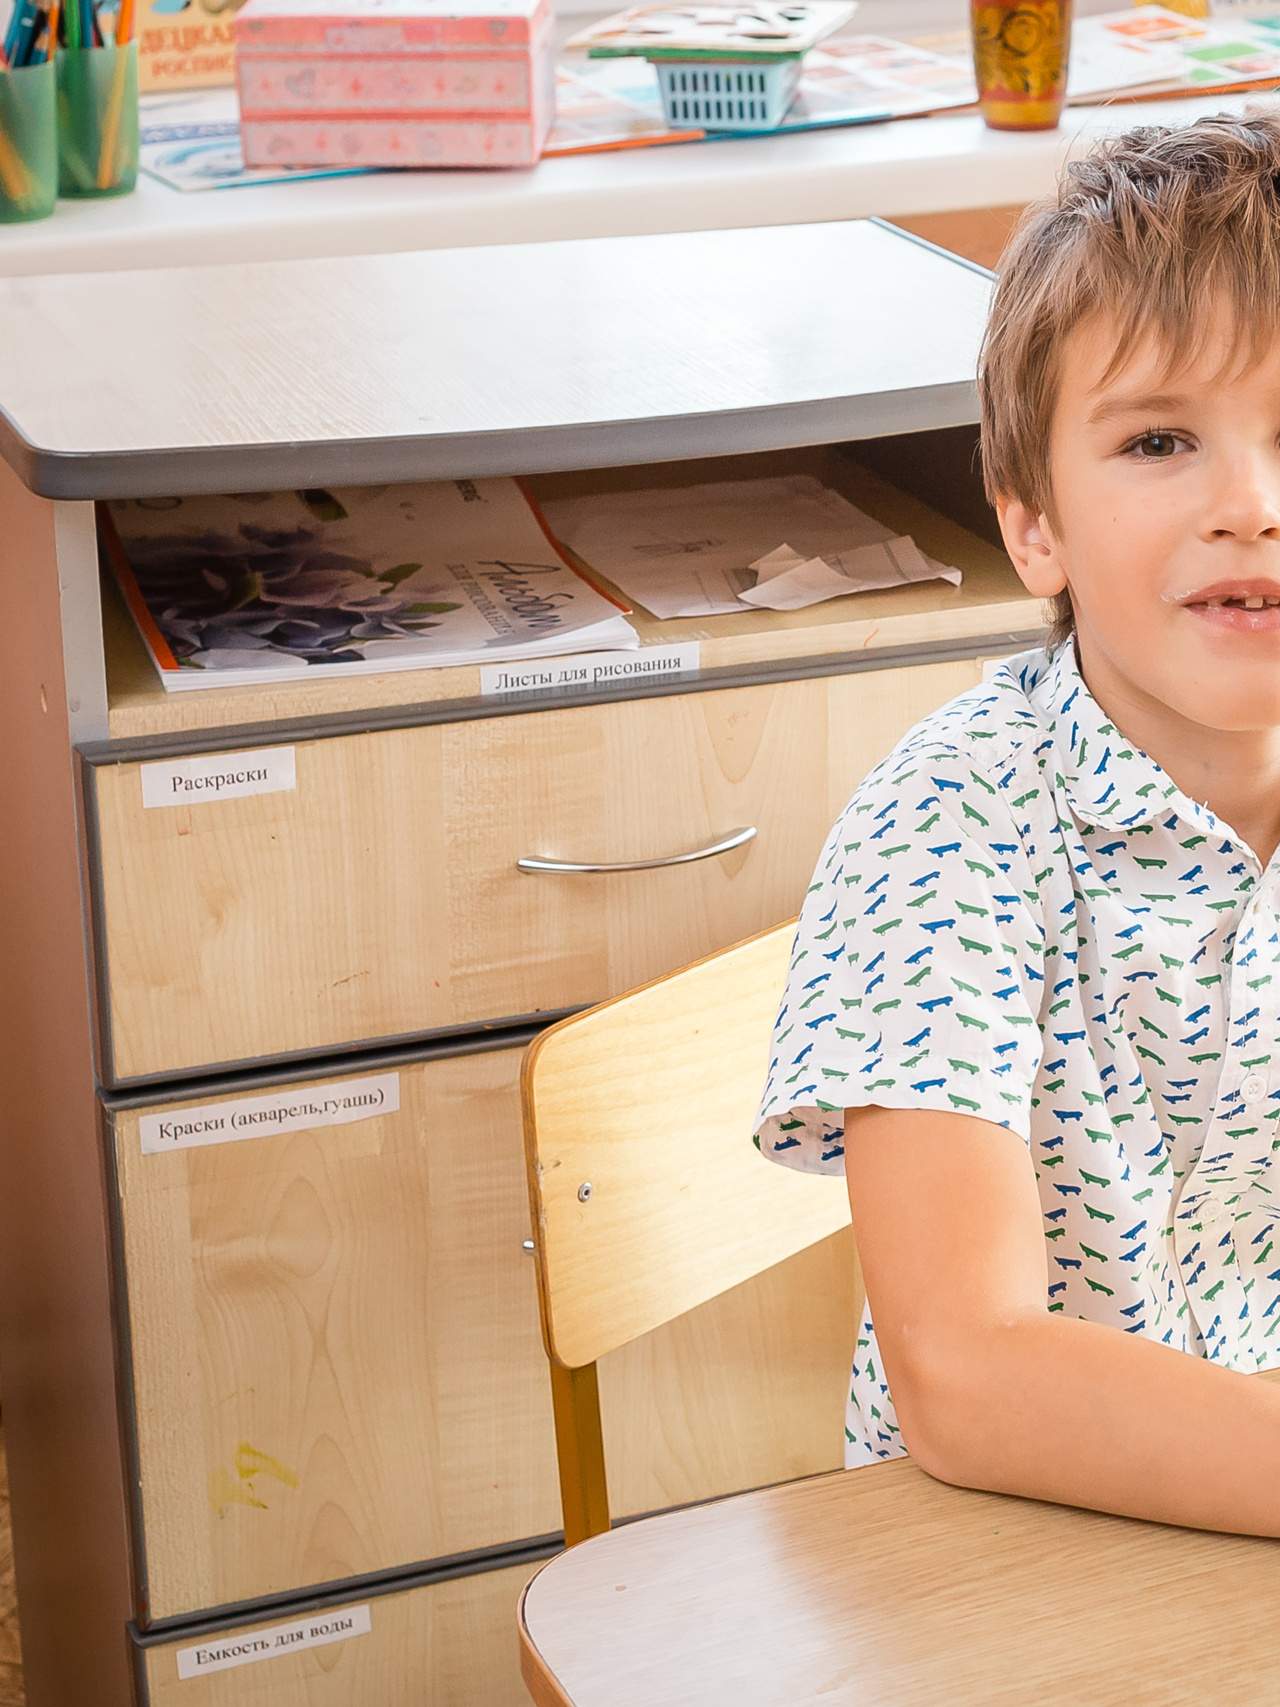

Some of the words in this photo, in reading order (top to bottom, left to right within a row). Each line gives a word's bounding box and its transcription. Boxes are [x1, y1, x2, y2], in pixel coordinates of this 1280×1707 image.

[495, 673, 552, 690] Листы
[558, 667, 588, 684] для
[593, 656, 682, 686] рисования
[171, 768, 268, 793] Раскраски
[158, 1116, 226, 1141] Краски
[230, 1088, 385, 1131] (акварель,гуашь)
[196, 1639, 270, 1665] Емкость
[274, 1630, 305, 1648] для
[309, 1618, 354, 1639] воды
